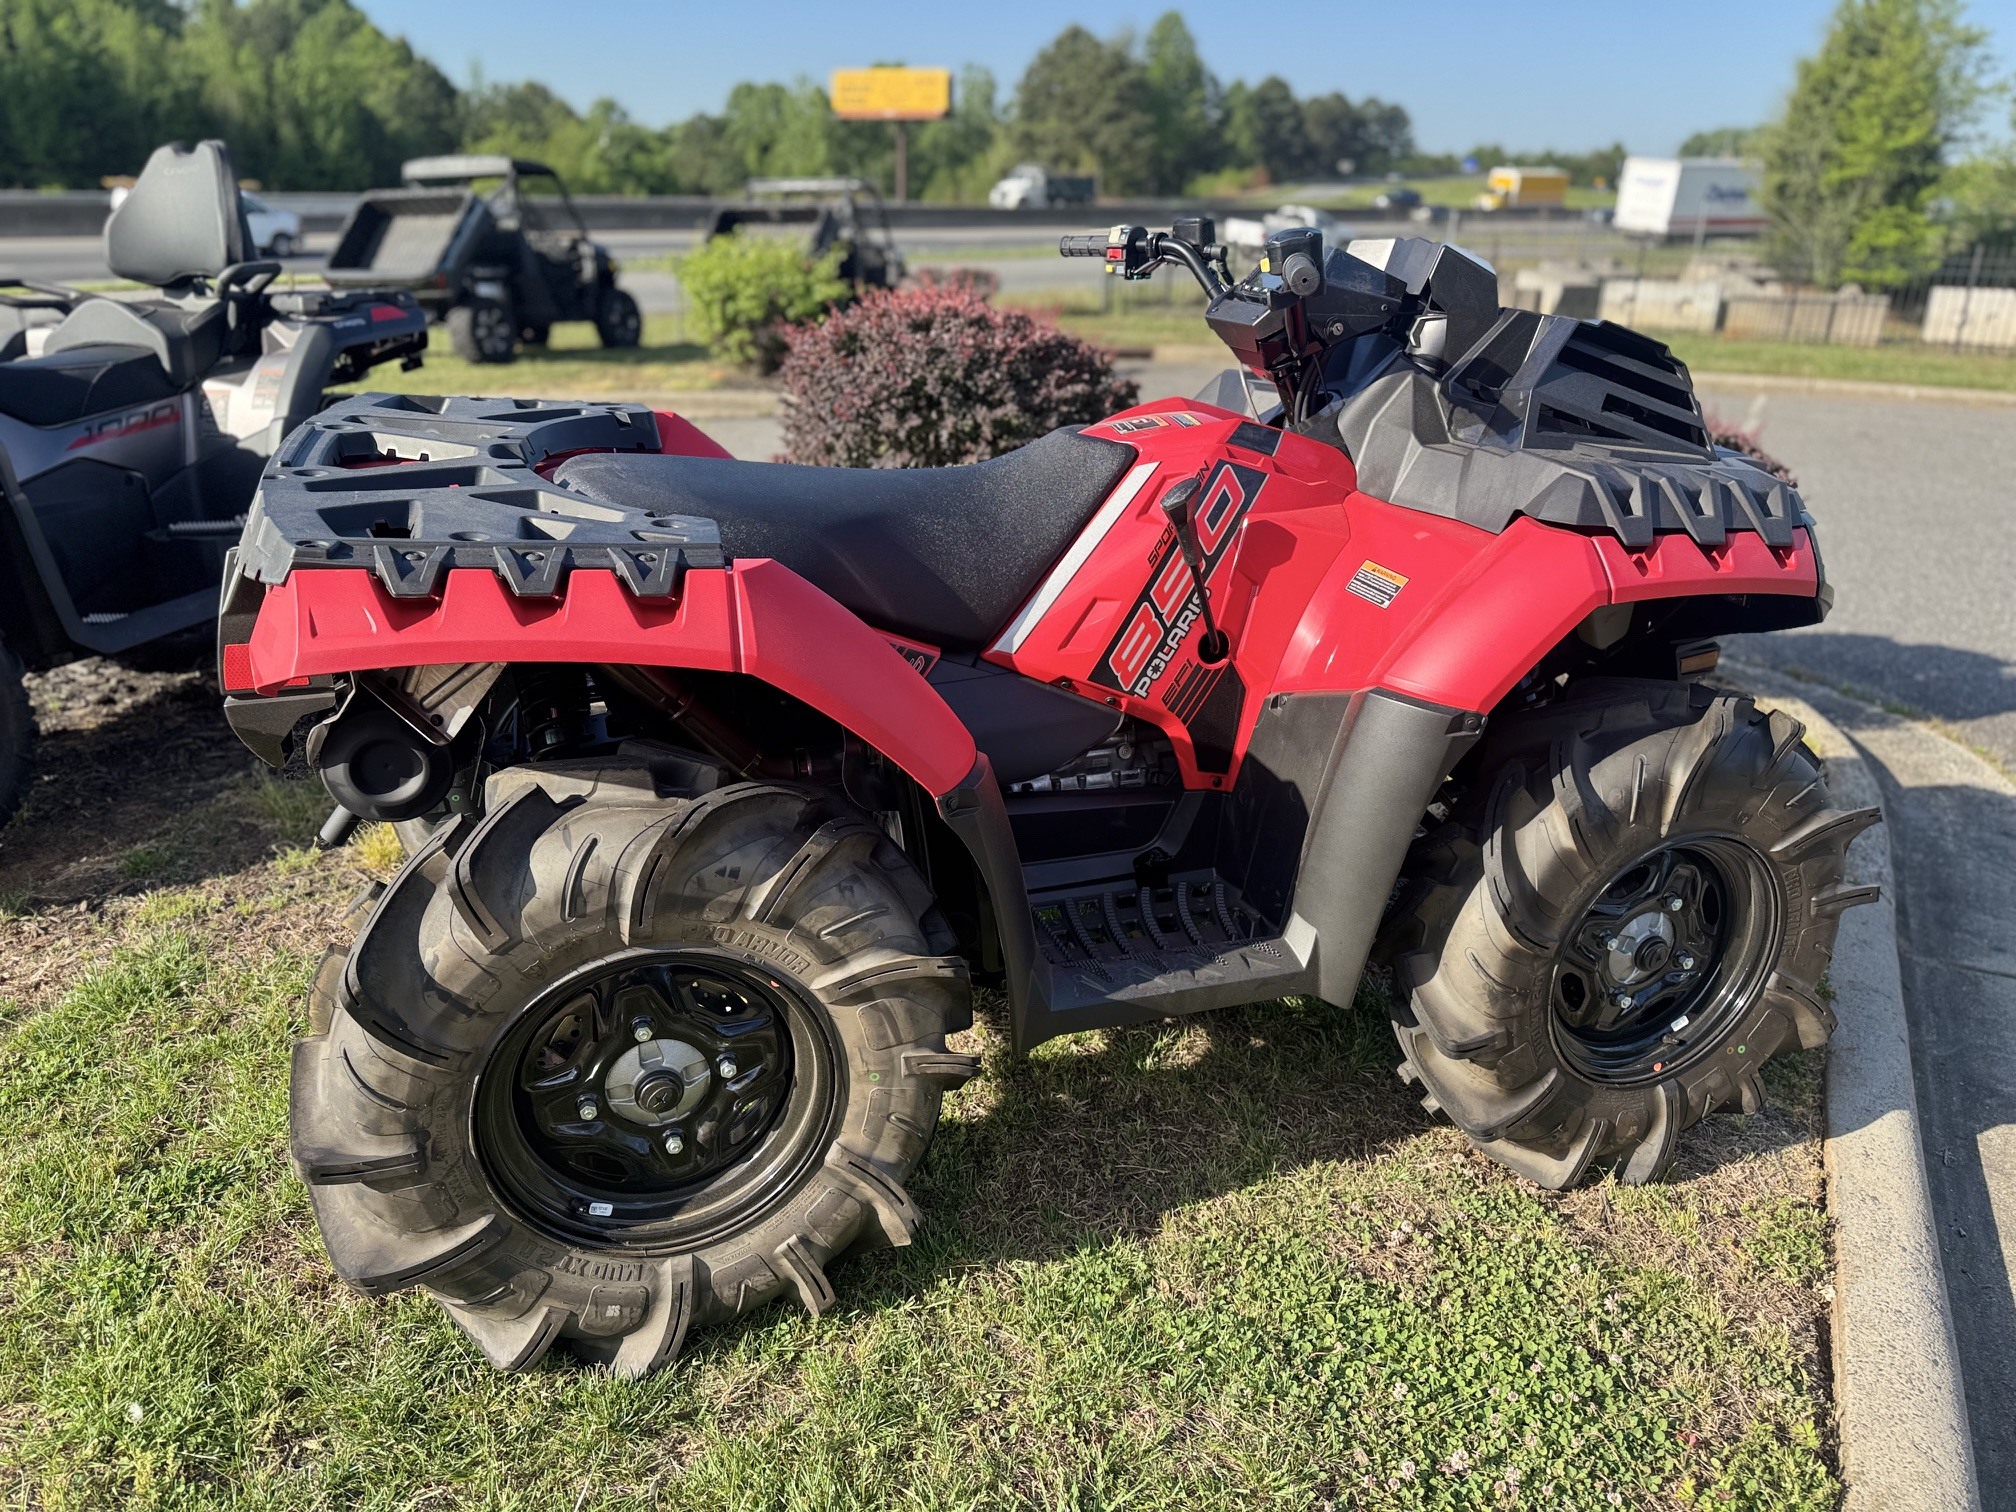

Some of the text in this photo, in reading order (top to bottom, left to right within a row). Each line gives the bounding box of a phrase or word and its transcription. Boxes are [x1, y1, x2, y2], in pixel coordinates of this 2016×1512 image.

[1108, 464, 1246, 692] 850
[1134, 587, 1212, 699] POLARIS
[1161, 658, 1194, 705] EFI
[681, 924, 735, 943] PRO
[733, 931, 811, 975] ARMOR
[554, 1255, 590, 1277] XT
[589, 1262, 644, 1281] MUD
